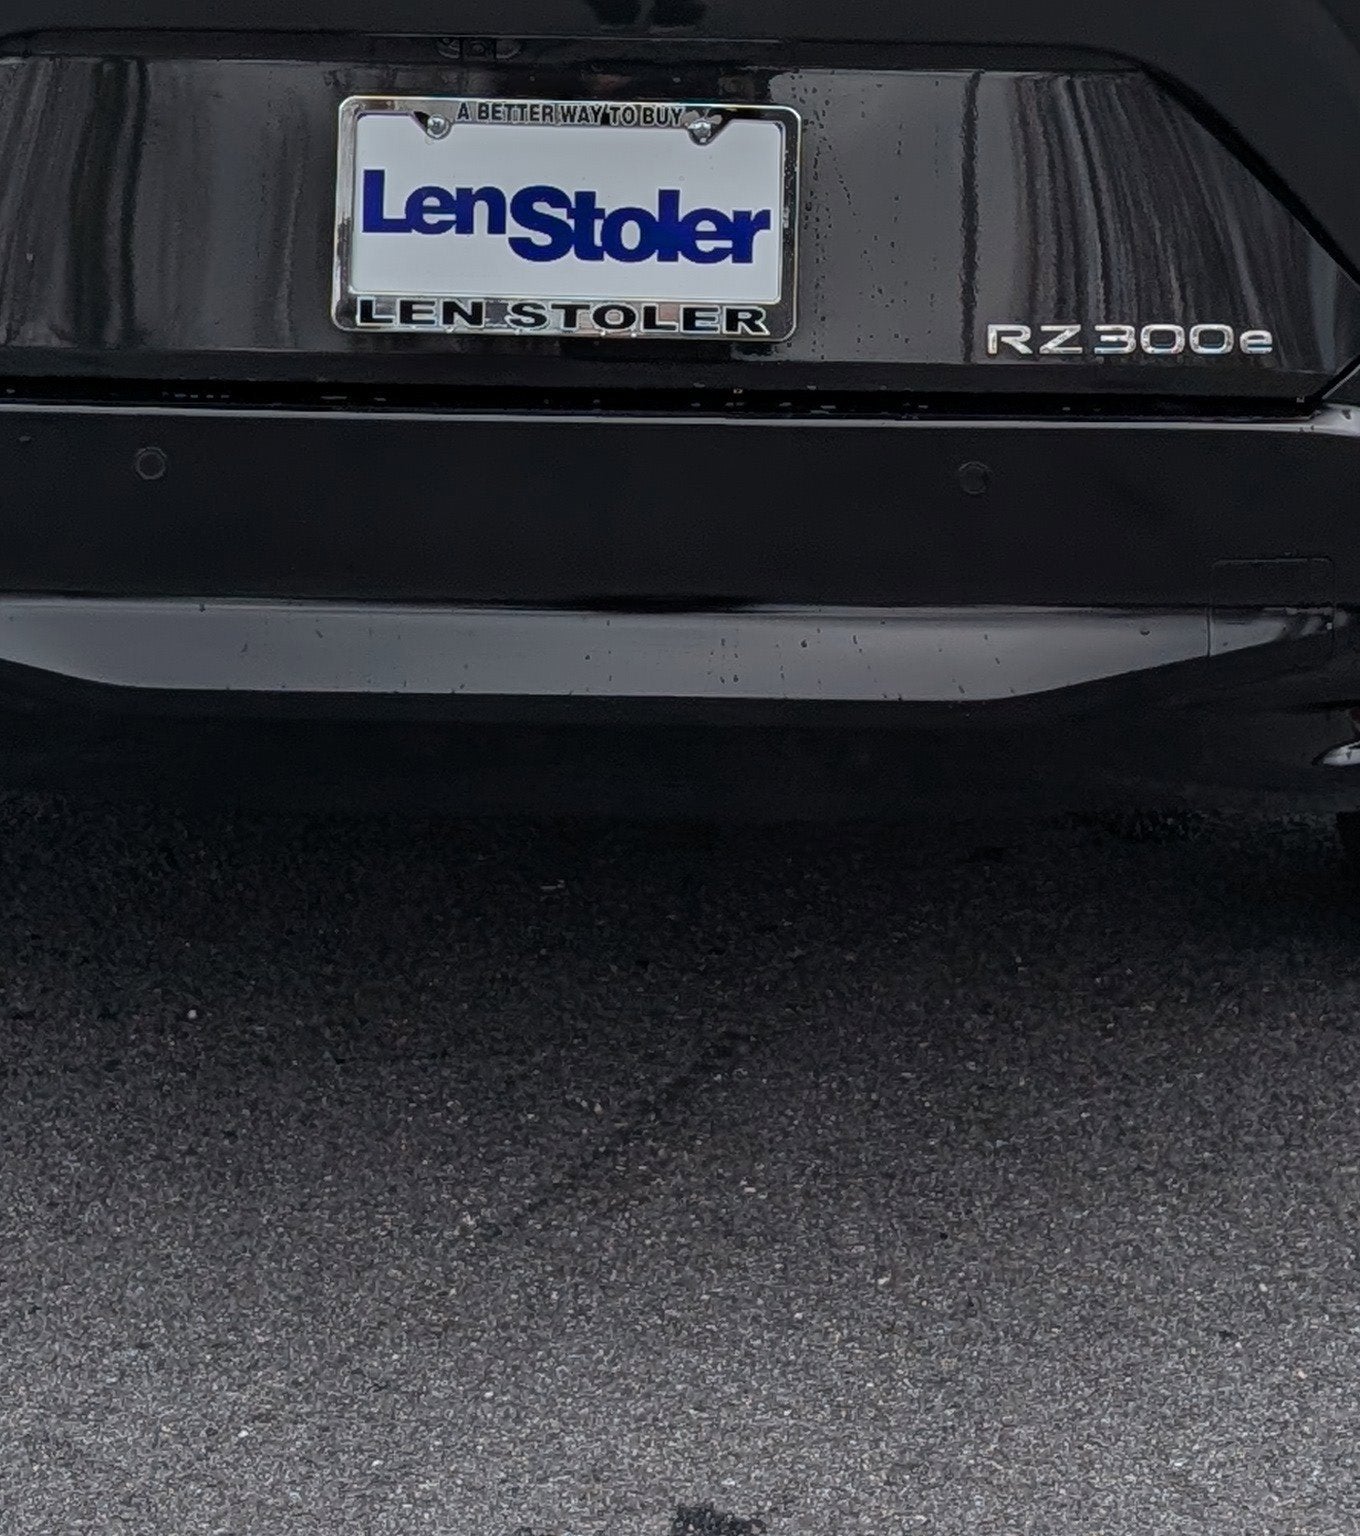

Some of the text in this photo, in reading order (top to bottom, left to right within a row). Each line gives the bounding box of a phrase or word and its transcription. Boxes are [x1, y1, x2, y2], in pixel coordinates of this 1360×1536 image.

[456, 101, 683, 127] A BETTER WAY TO BUY
[355, 296, 770, 336] LEN STOLER
